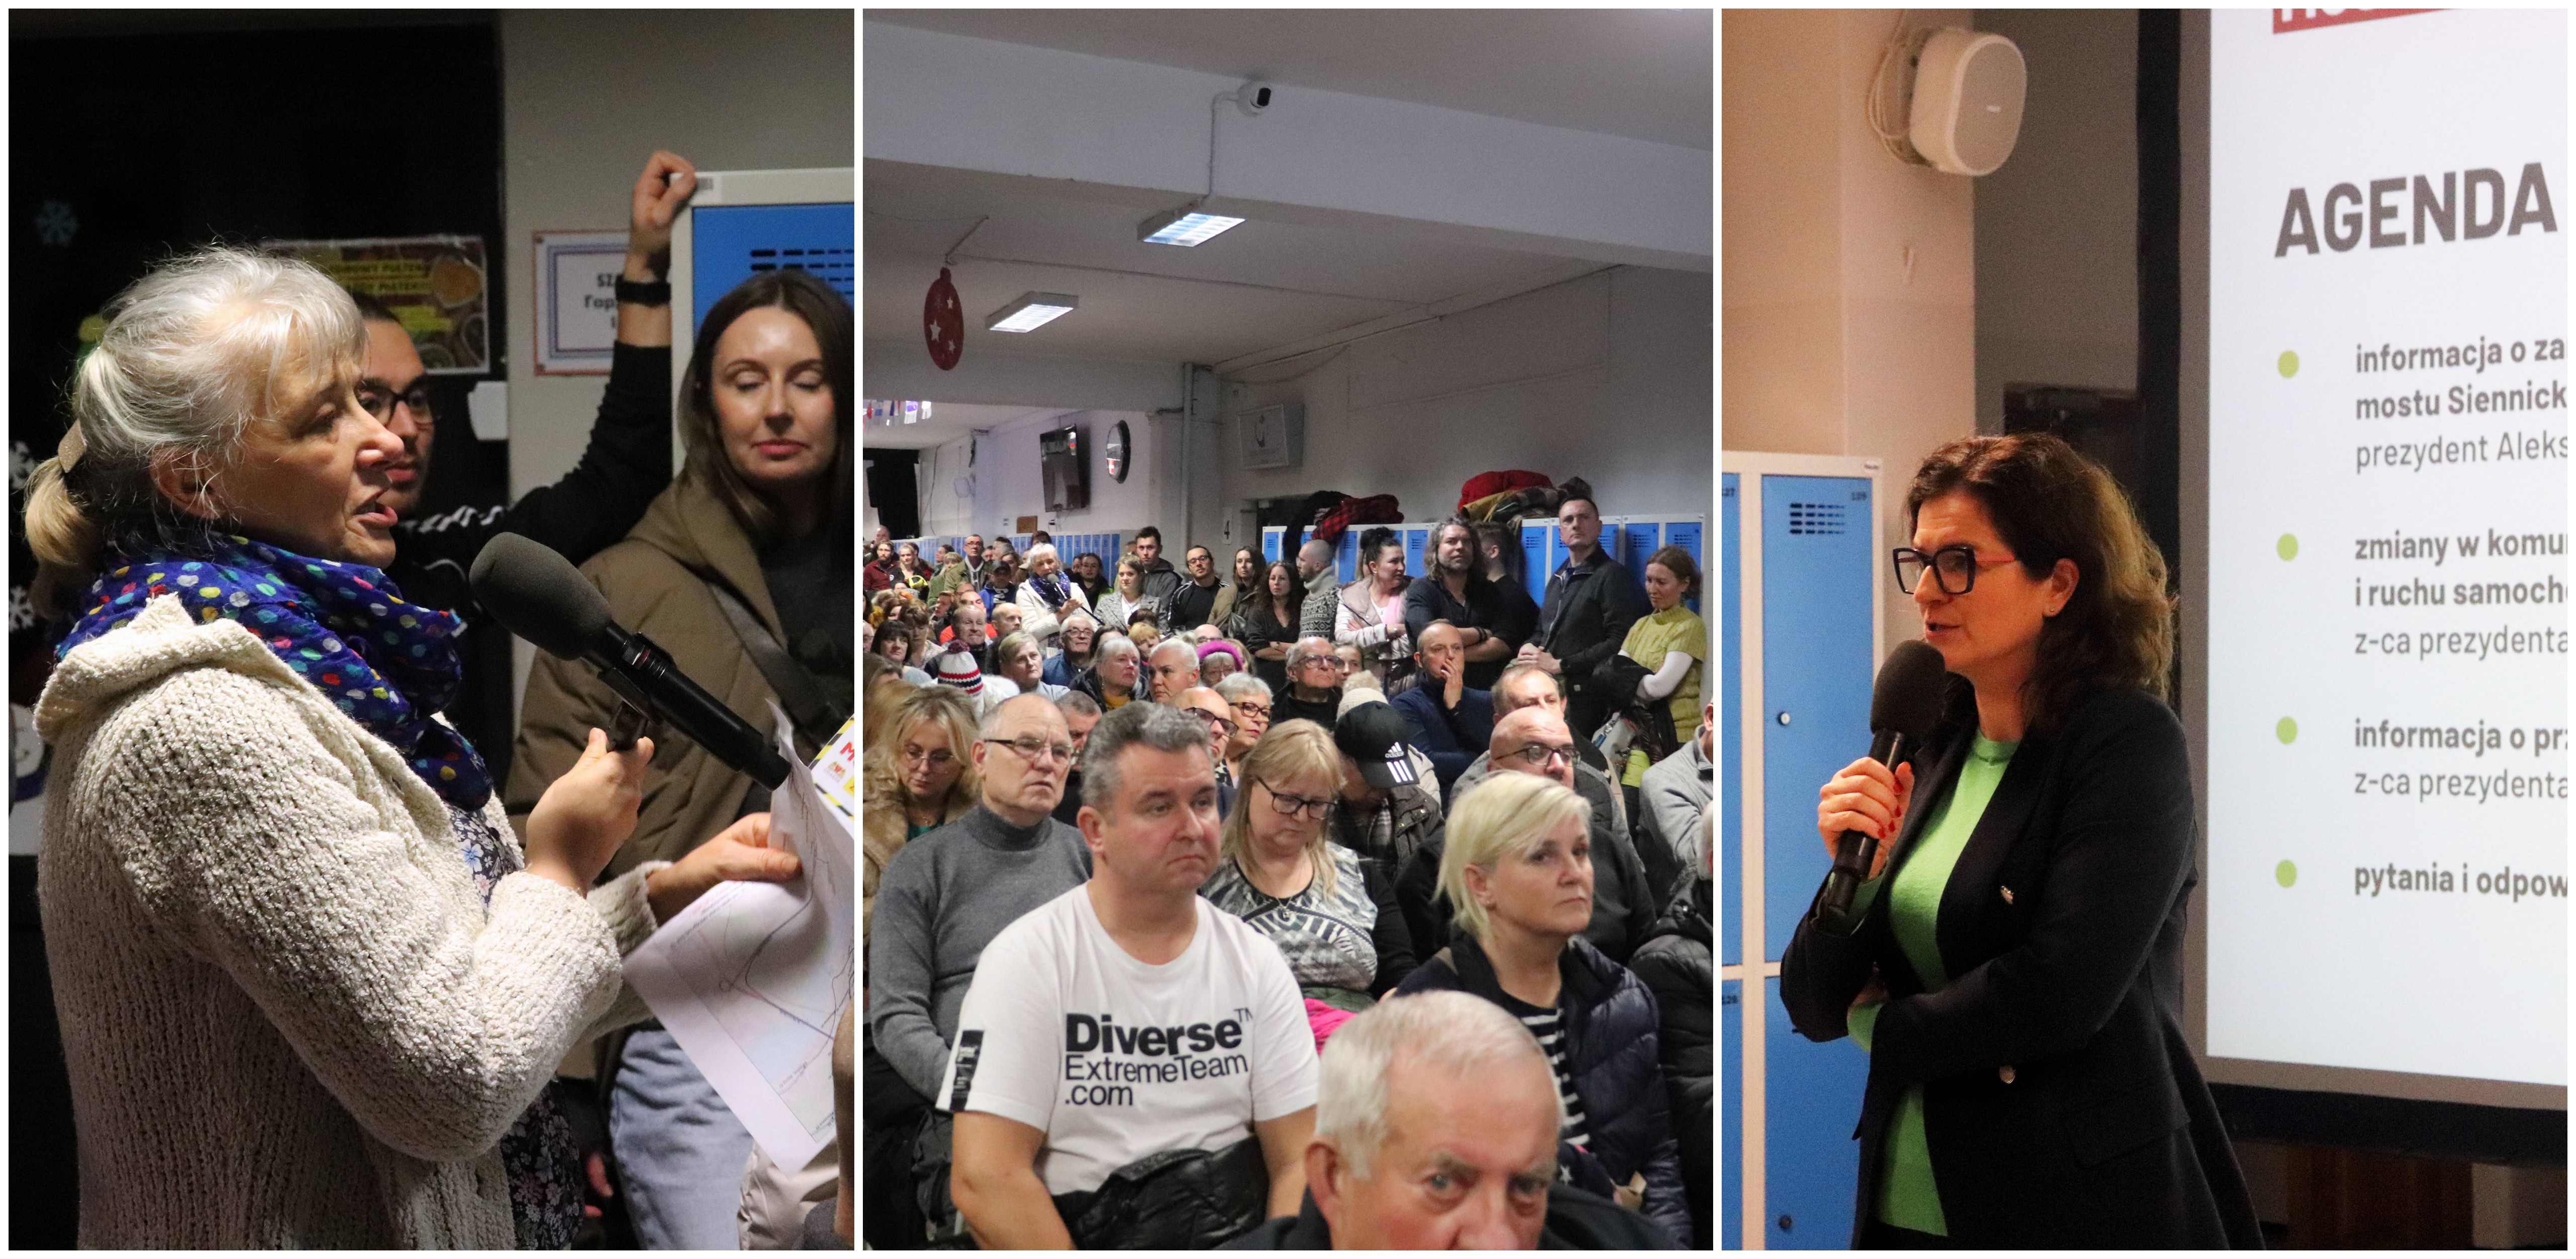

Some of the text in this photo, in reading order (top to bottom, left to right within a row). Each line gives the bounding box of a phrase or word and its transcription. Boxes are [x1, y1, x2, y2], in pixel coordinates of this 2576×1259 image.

[2274, 162, 2557, 258] AGENDA
[2356, 336, 2567, 374] informacja o za
[2356, 380, 2567, 419] mostu Siennick
[2356, 430, 2567, 474] prezydent Aleks
[1224, 520, 1230, 540] 4
[2355, 528, 2567, 566] zmiany w komu
[2355, 574, 2567, 606] i ruchu samoch
[2355, 625, 2567, 661] z-ca prezydenta
[2355, 717, 2567, 758] informacja o pr
[2355, 769, 2567, 804] z-ca prezydenta
[2355, 861, 2567, 903] pytania i odpow
[1066, 1014, 1242, 1057] Diverse
[1066, 1052, 1249, 1083] ExtremeTeam
[1065, 1083, 1134, 1107] .com
